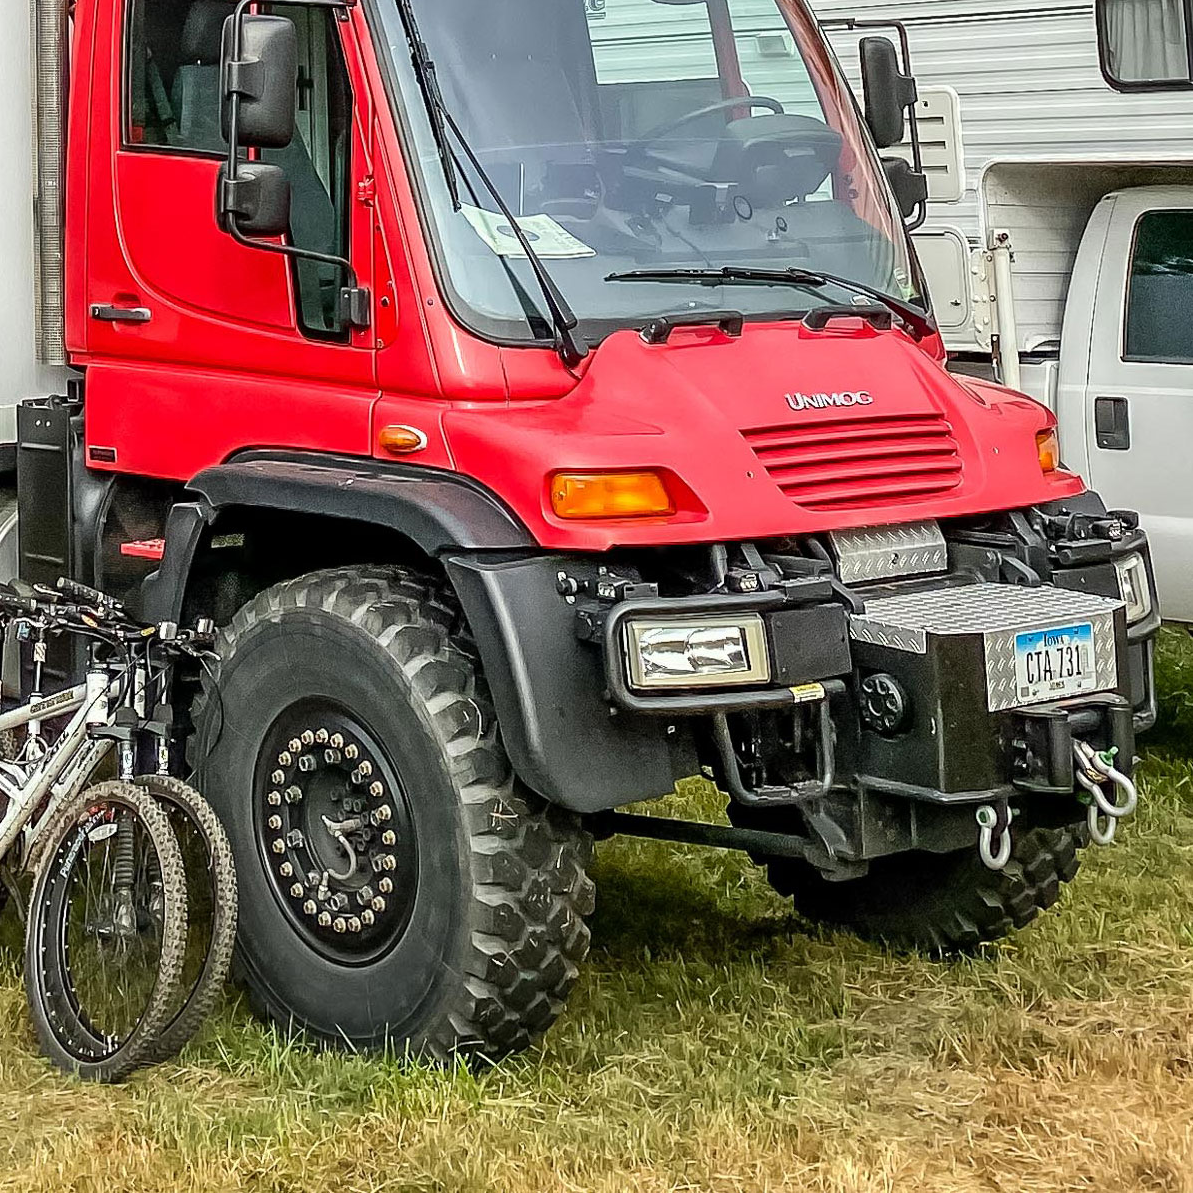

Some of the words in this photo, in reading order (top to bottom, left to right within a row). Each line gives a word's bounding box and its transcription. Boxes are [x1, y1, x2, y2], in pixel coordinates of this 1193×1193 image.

[784, 390, 874, 411] UNIMOG
[1026, 649, 1053, 684] CTA
[1057, 644, 1082, 678] 731
